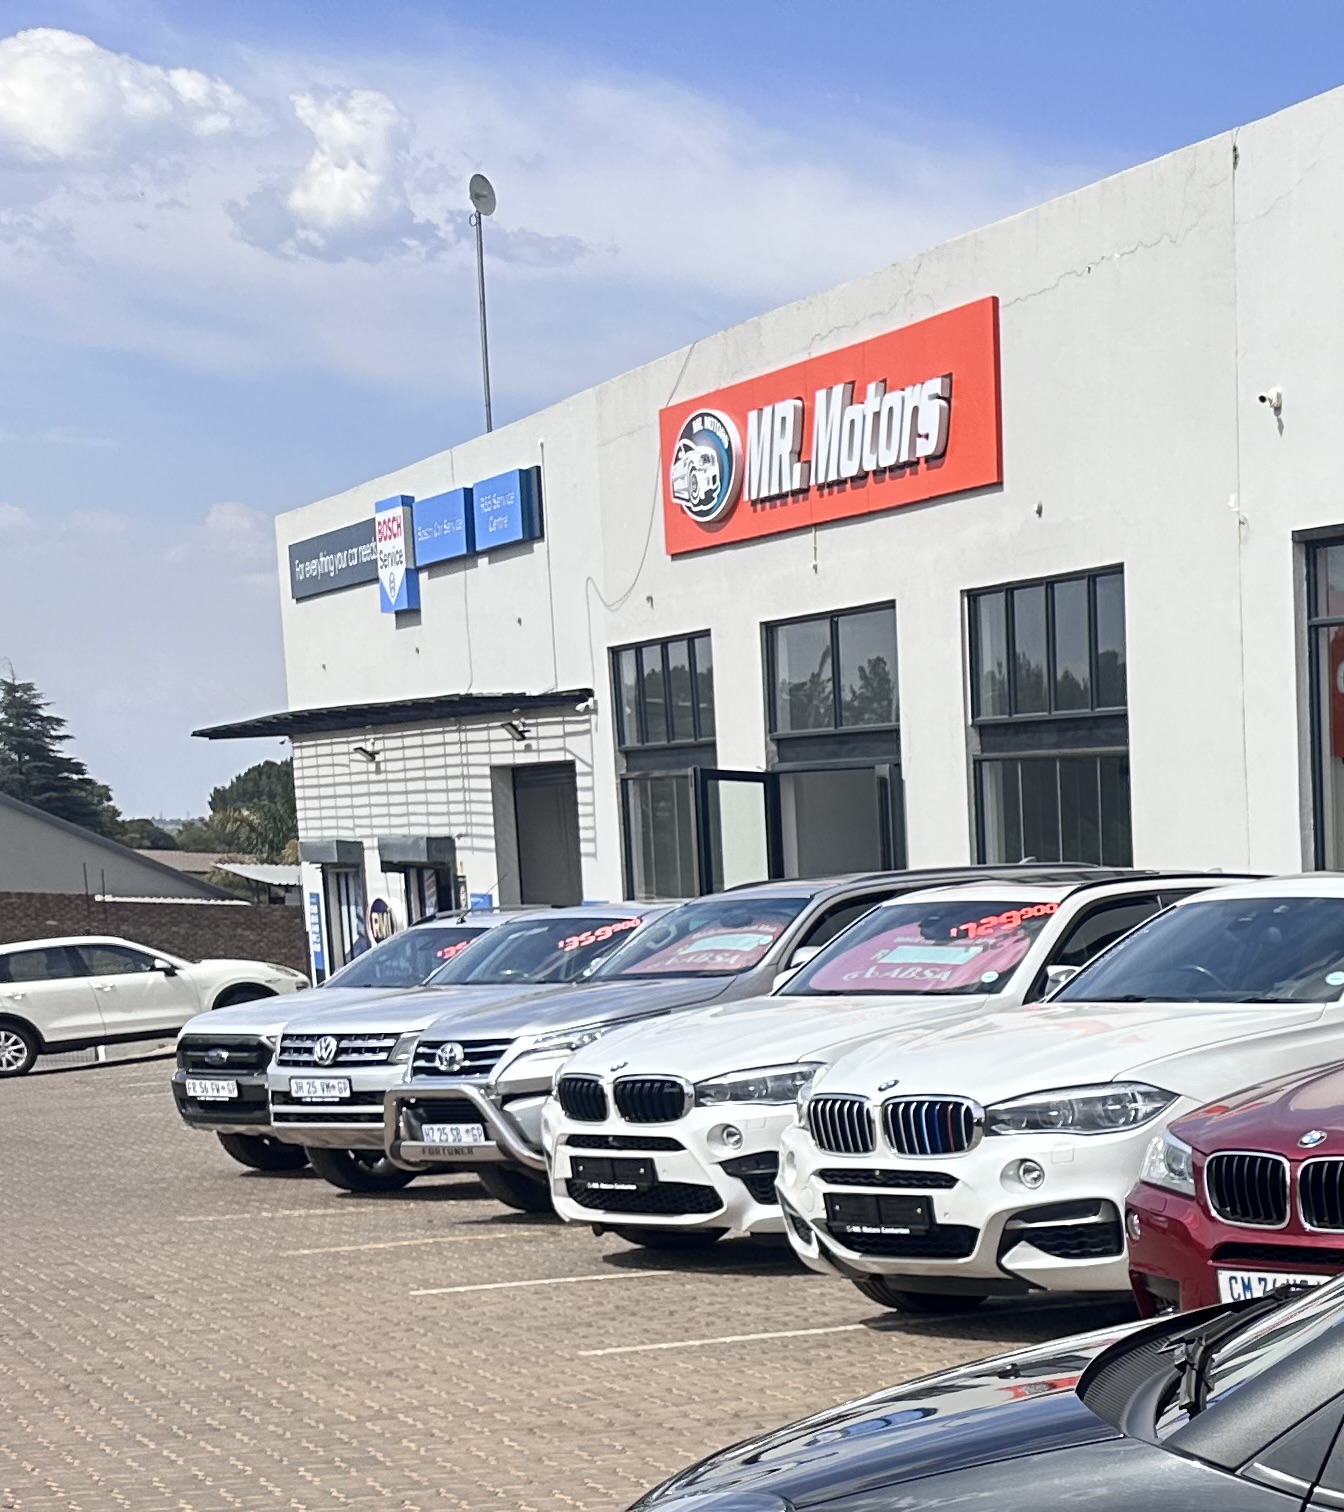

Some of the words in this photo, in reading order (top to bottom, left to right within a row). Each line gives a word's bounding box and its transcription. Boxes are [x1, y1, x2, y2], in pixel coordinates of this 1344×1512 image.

[746, 396, 810, 502] MR.
[810, 375, 951, 486] Motors
[378, 514, 402, 543] BOSCH
[380, 544, 403, 569] Service
[883, 966, 953, 982] ABSA
[338, 1081, 348, 1093] GP
[1228, 1276, 1253, 1301] CM
